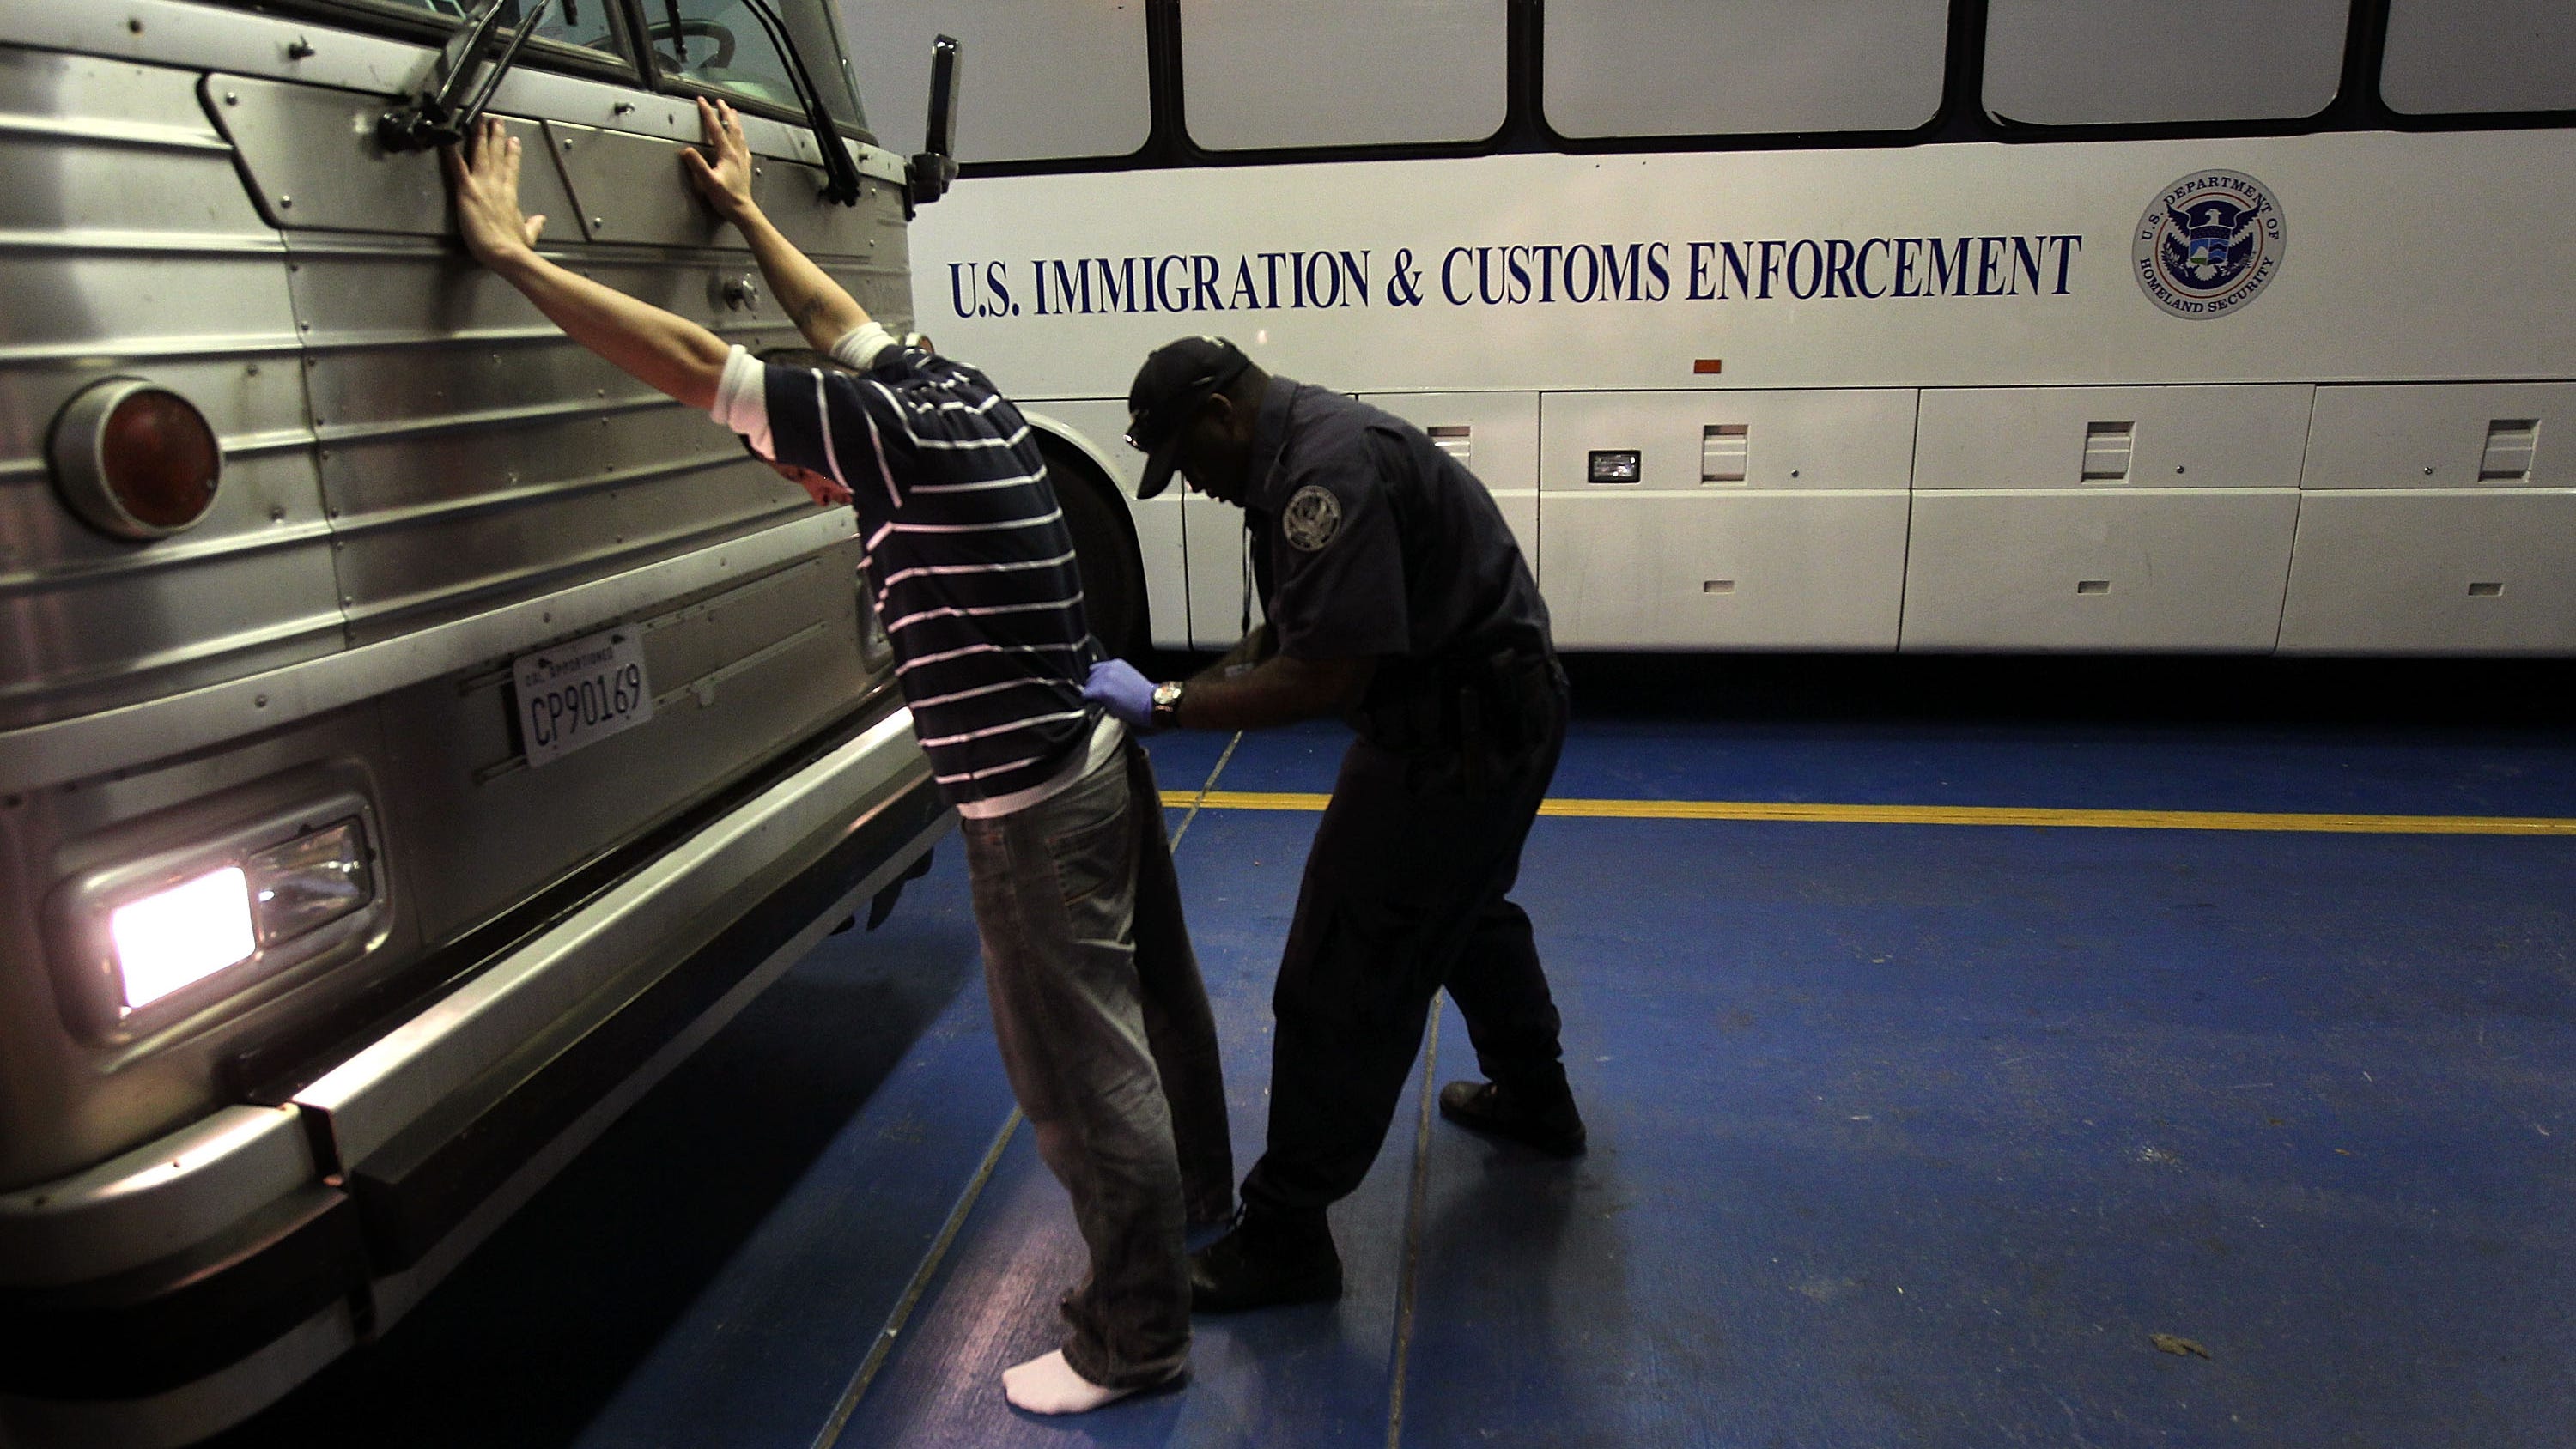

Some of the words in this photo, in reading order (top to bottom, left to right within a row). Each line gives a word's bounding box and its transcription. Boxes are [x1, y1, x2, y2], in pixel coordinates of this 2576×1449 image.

[2142, 211, 2165, 240] U.S.
[2163, 176, 2272, 215] DEPARTMENT
[2266, 218, 2280, 240] OF
[948, 260, 1020, 318] U.S.
[1031, 249, 1371, 315] IMMIGRATION
[1386, 246, 1425, 307] &
[1441, 241, 1671, 306] CUSTOMS
[1685, 234, 2082, 301] ENFORCEMENT
[2140, 257, 2204, 313] HOMELAND
[2208, 256, 2275, 312] SECURITY
[531, 663, 641, 747] CP90169
